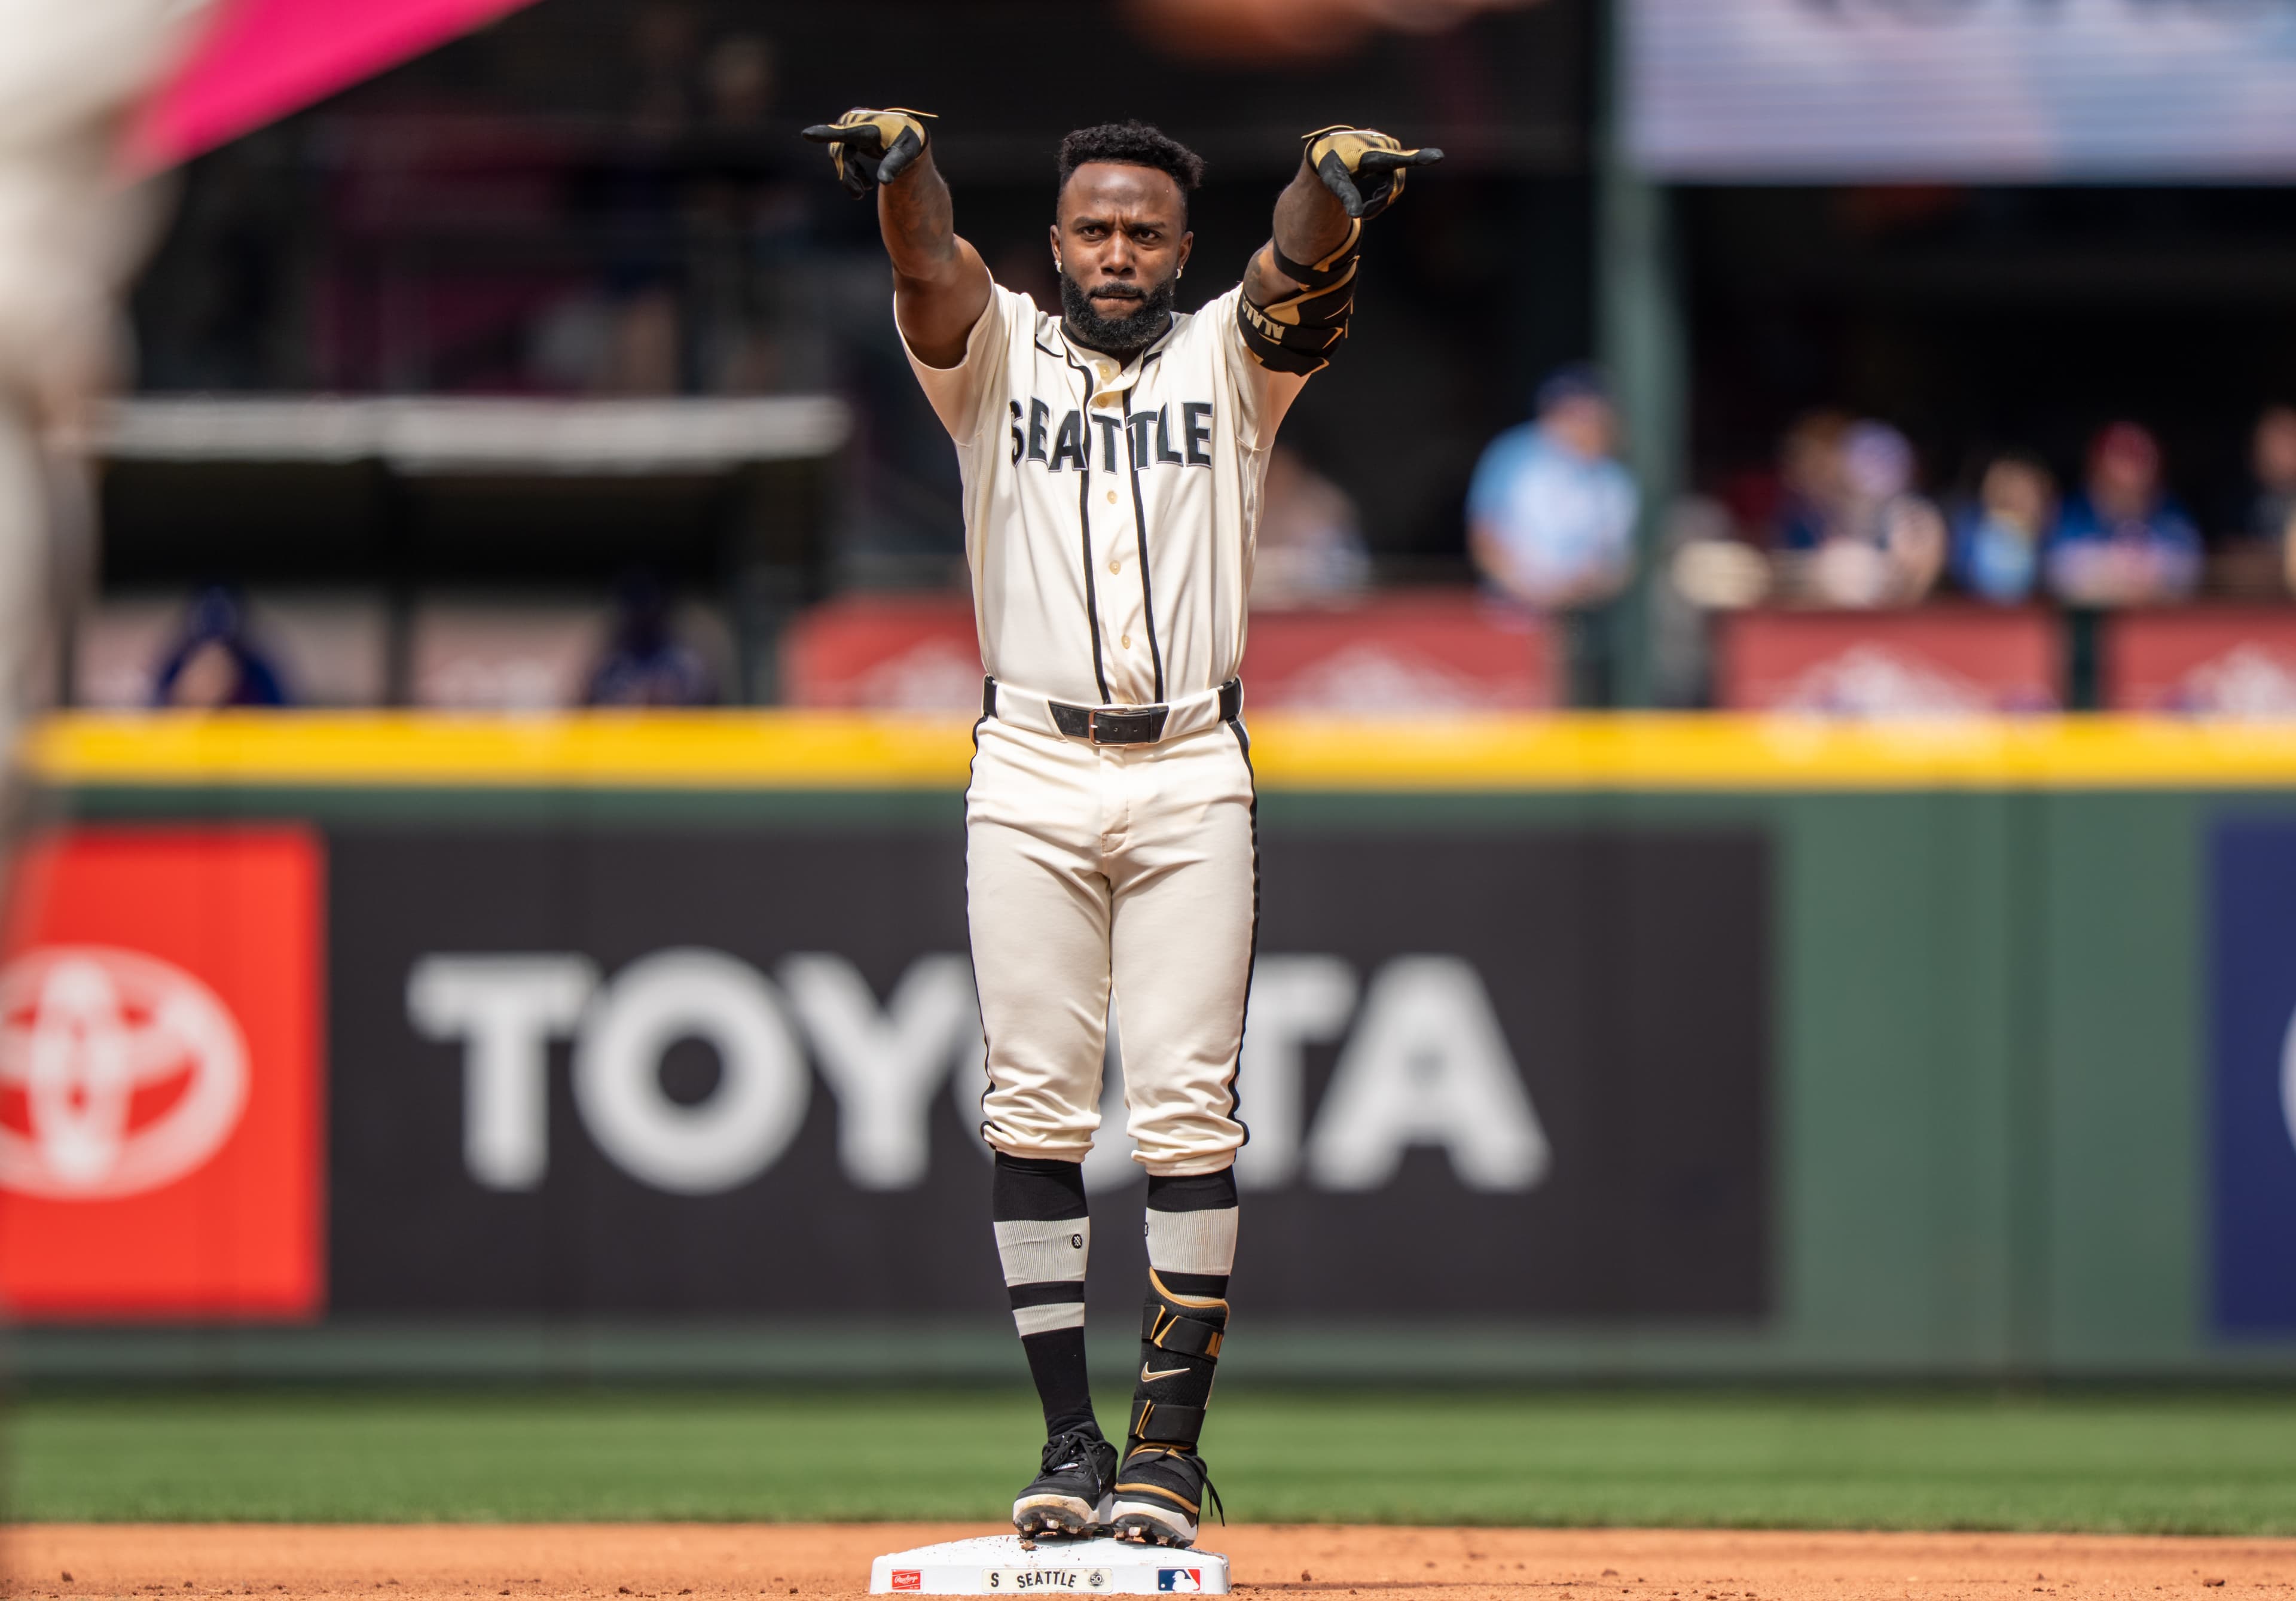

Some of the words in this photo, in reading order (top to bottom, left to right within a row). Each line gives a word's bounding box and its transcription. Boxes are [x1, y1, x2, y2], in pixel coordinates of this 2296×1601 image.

[1009, 397, 1213, 475] SEATTLE
[409, 950, 1549, 1193] TOYTA
[990, 1572, 999, 1587] S
[1016, 1571, 1077, 1588] SEATTLE
[1090, 1572, 1103, 1582] 50
